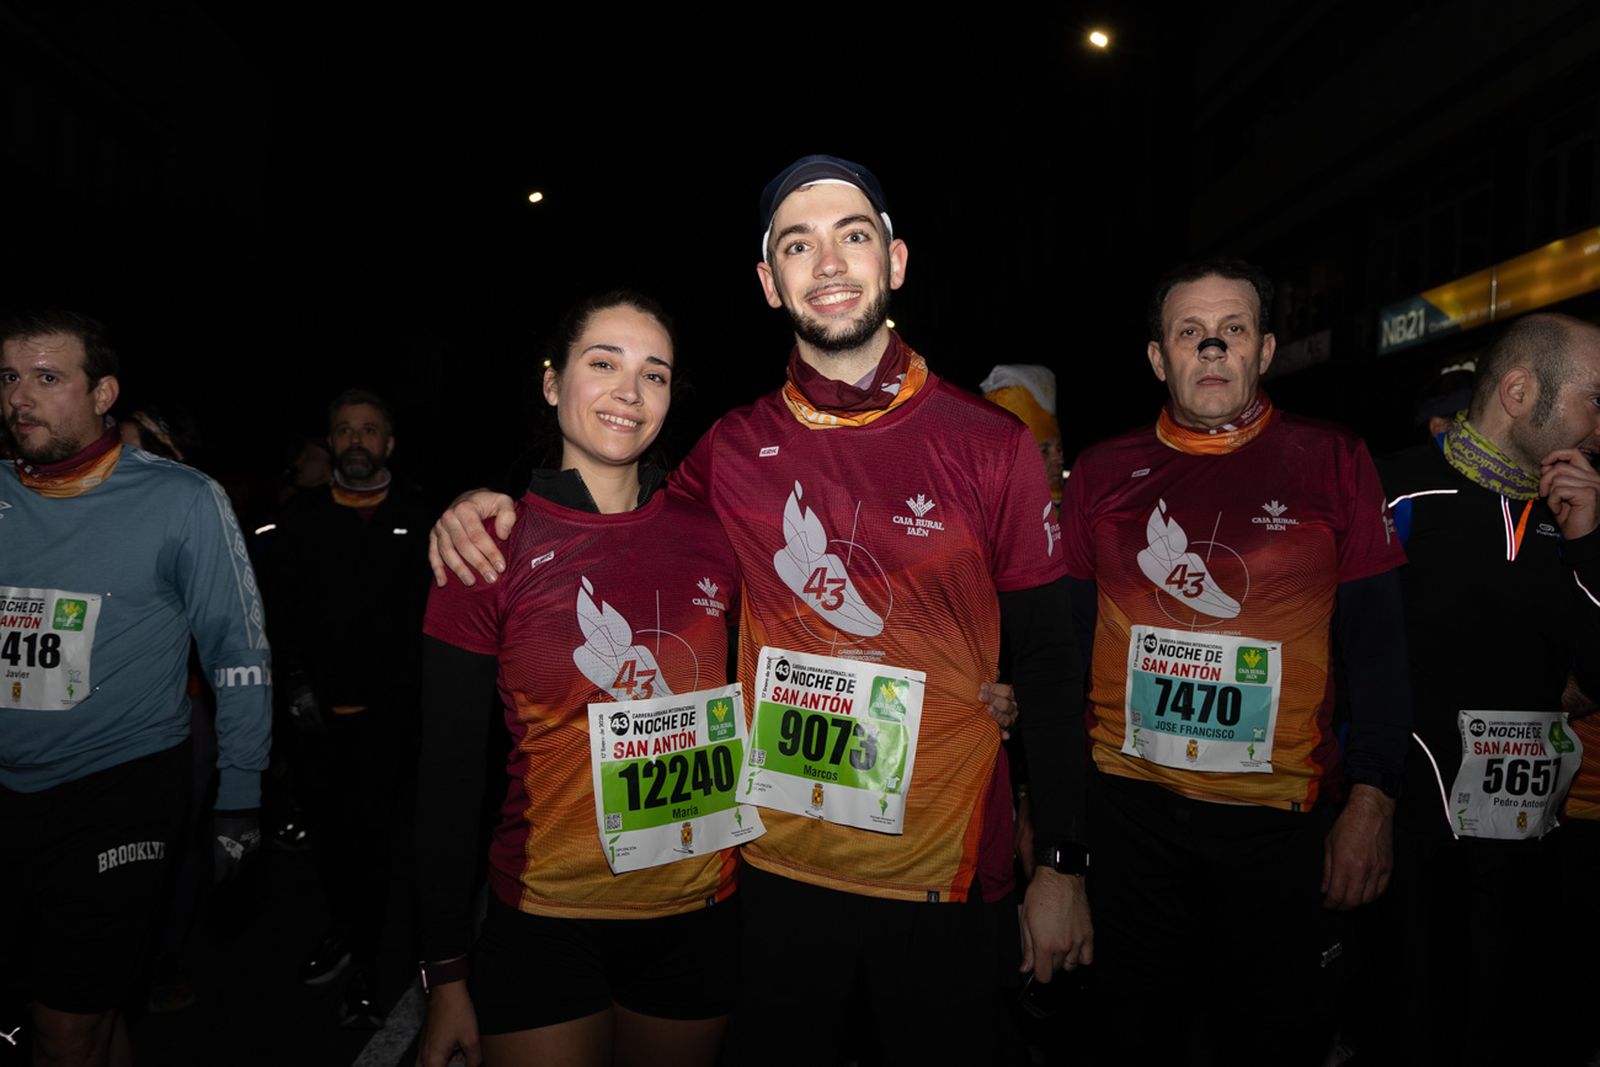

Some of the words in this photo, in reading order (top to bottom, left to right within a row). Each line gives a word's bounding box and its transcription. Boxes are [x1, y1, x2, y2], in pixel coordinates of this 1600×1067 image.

[1381, 306, 1426, 348] NB21
[892, 515, 914, 526] CAJA
[915, 517, 944, 531] RURAL
[802, 567, 847, 611] 43
[1165, 564, 1205, 598] 43
[0, 600, 27, 613] OCHE
[29, 601, 45, 614] DE
[0, 631, 61, 669] 418
[1158, 643, 1202, 661] NOCHE
[1204, 650, 1223, 663] DE
[5, 669, 30, 679] Javier
[612, 659, 656, 701] 43
[776, 664, 790, 678] 43
[1141, 657, 1168, 674] SAN
[1170, 662, 1222, 682] ANTÓN
[790, 670, 832, 690] NOCHE
[835, 677, 857, 694] DE
[771, 686, 799, 705] SAN
[801, 692, 854, 715] ANTÓN
[1155, 677, 1242, 727] 7470
[612, 717, 628, 729] 43
[633, 716, 678, 735] NOCHE
[680, 711, 696, 728] DE
[1155, 720, 1177, 733] JOSE
[1179, 723, 1235, 740] FRANCISCO
[1470, 723, 1485, 733] 43
[1488, 727, 1530, 739] NOCHE
[613, 739, 648, 759] SAN
[653, 728, 697, 755] ANTÓN
[778, 709, 878, 771] 9073
[1474, 741, 1500, 755] SAN
[1502, 739, 1547, 756] ANTÓN
[618, 745, 735, 811] 12240
[803, 765, 838, 781] Marcos
[1493, 797, 1519, 808] Pedro
